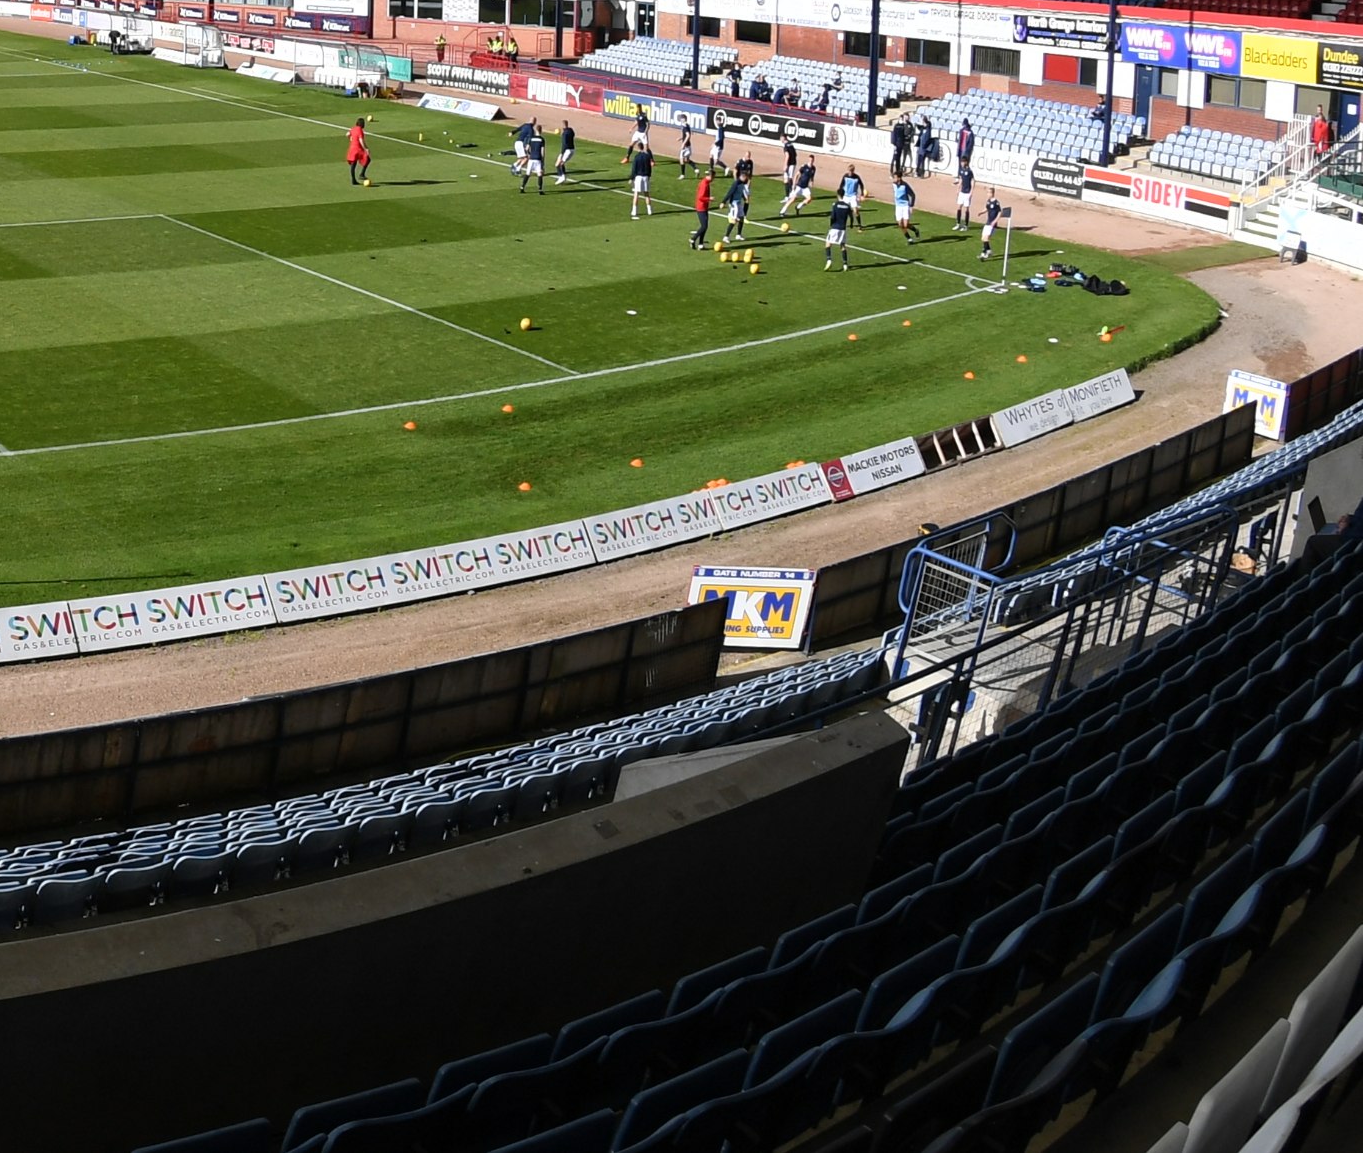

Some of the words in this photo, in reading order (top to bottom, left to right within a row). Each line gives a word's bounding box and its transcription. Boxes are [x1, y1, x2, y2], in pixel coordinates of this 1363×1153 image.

[1027, 15, 1047, 28] North
[1048, 17, 1075, 34] Grange
[1076, 19, 1107, 34] Interiors
[1126, 27, 1163, 48] WAVE
[1185, 31, 1225, 54] WAVE
[1244, 47, 1307, 70] Blackadders
[1323, 47, 1359, 65] Dundee
[427, 63, 451, 76] SCOTT
[451, 66, 473, 80] FYFFE
[474, 69, 509, 86] MOTORS
[528, 77, 569, 106] PUMA
[726, 116, 744, 127] SPORT
[761, 122, 779, 133] SPORT
[798, 127, 817, 139] SPORT
[1132, 178, 1183, 209] SIDEY
[1004, 398, 1054, 426] WHYTES
[1068, 374, 1123, 405] MONIFIETH
[848, 455, 879, 474] MACKIE
[880, 445, 915, 463] MOTORS
[872, 463, 903, 481] NISSAN
[756, 470, 822, 503] SWITCH
[678, 491, 754, 524] SWITCH
[594, 509, 675, 544] SWITCH
[496, 529, 587, 564] SWITCH
[394, 548, 489, 585] SWITCH
[713, 569, 737, 577] GATE
[740, 570, 780, 578] NUMBER
[785, 570, 795, 578] 14
[279, 566, 385, 603] SWITCH
[147, 584, 268, 623] SWITCH
[9, 601, 139, 646] SWITCH
[745, 624, 785, 634] SUPPLIES
